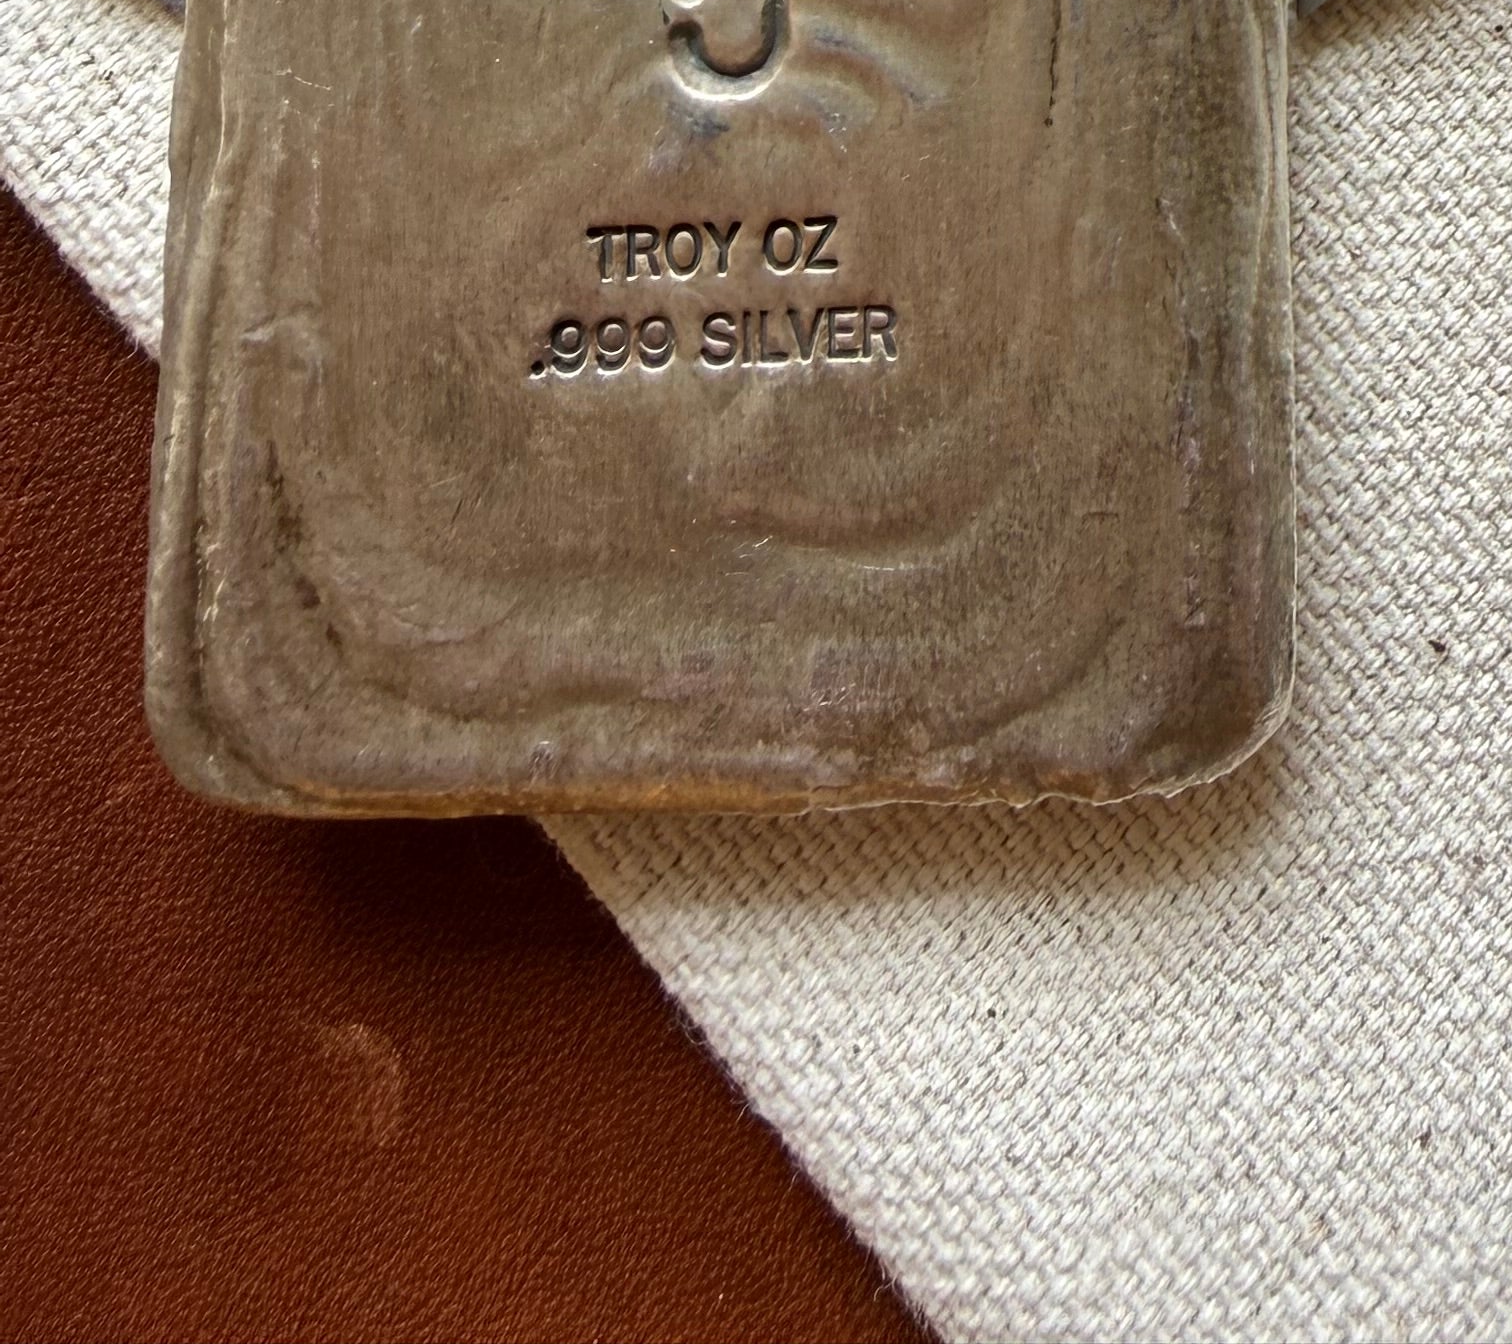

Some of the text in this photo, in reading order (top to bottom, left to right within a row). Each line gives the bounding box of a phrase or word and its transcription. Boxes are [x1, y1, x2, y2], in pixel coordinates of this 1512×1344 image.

[586, 215, 839, 282] TROY OZ
[528, 303, 900, 380] .999 SILVER
